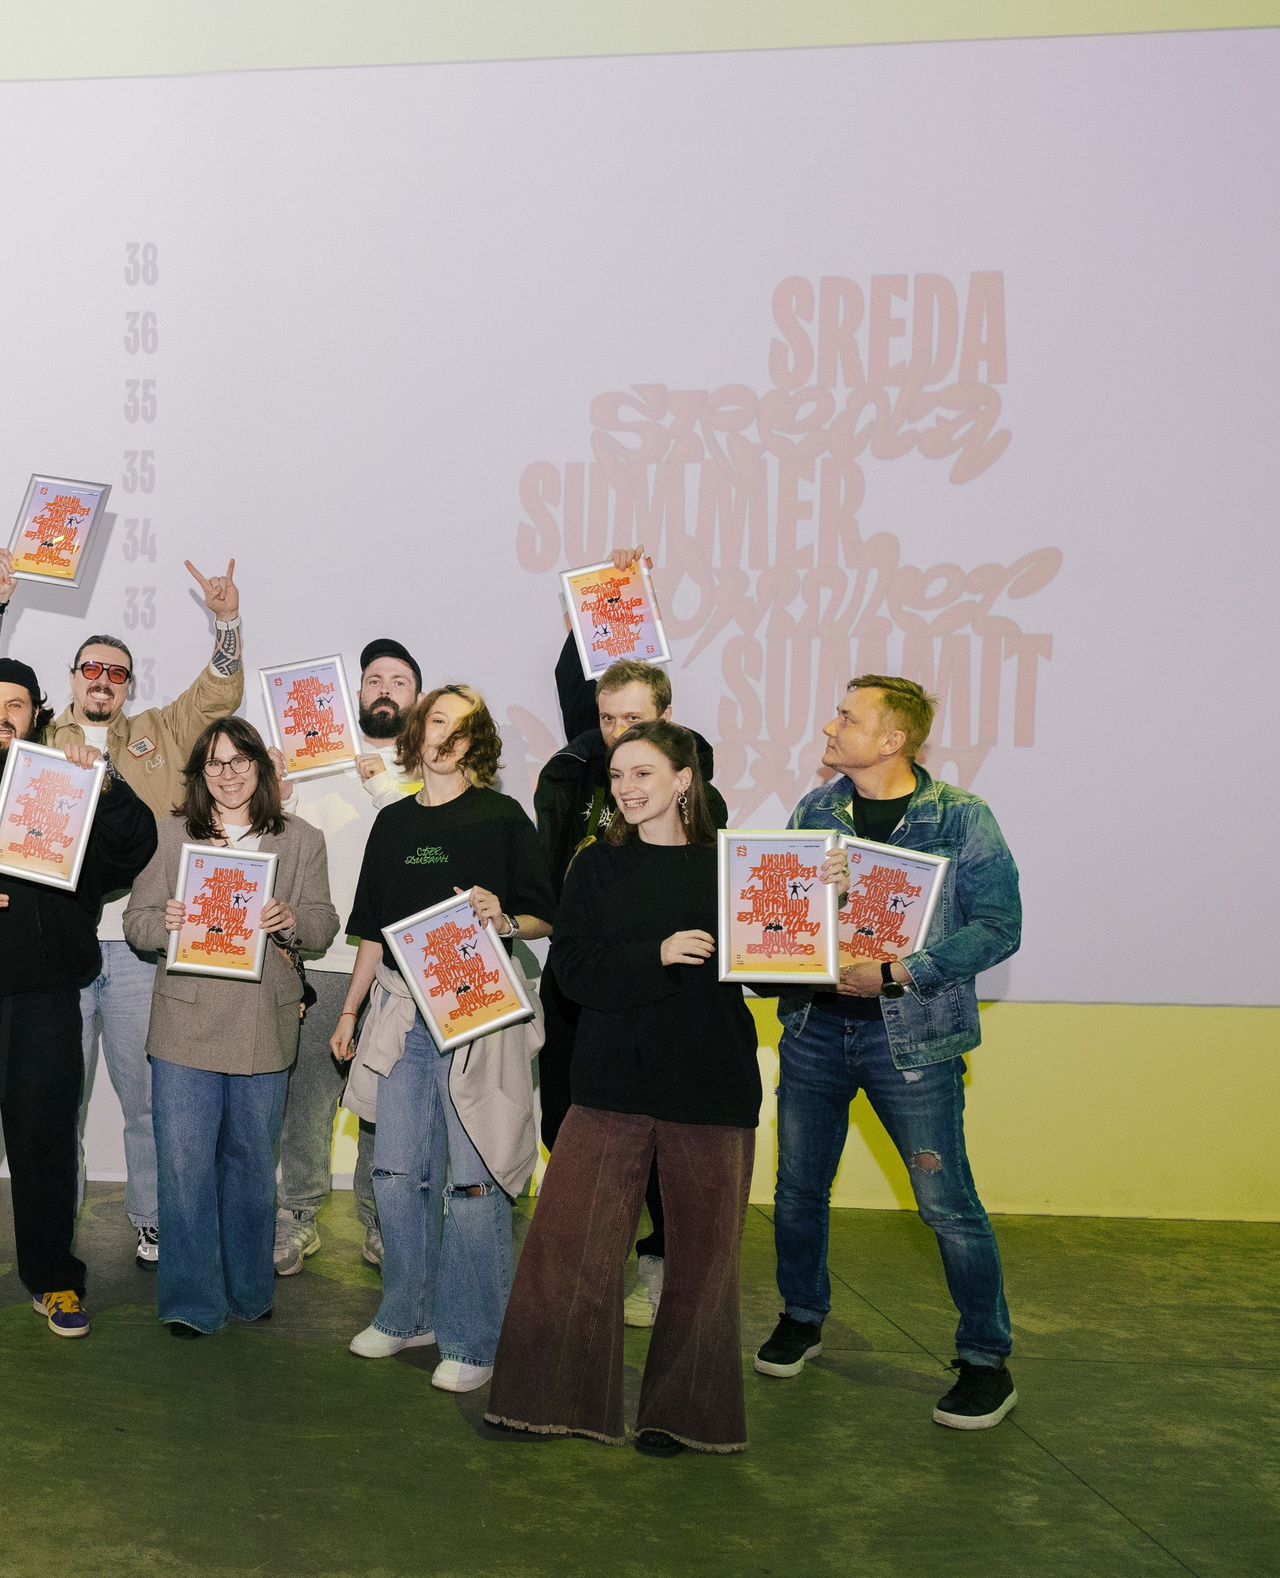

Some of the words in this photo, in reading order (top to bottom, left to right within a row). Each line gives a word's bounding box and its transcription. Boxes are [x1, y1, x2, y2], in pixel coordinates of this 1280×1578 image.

[124, 242, 159, 286] 38
[124, 311, 159, 355] 36
[769, 271, 1008, 390] SREDA
[124, 379, 157, 424] 35
[122, 450, 156, 494] 35
[516, 457, 866, 574] SUMMER
[123, 519, 157, 563] 34
[123, 587, 157, 631] 33
[760, 852, 798, 868] ДИЗАЙН
